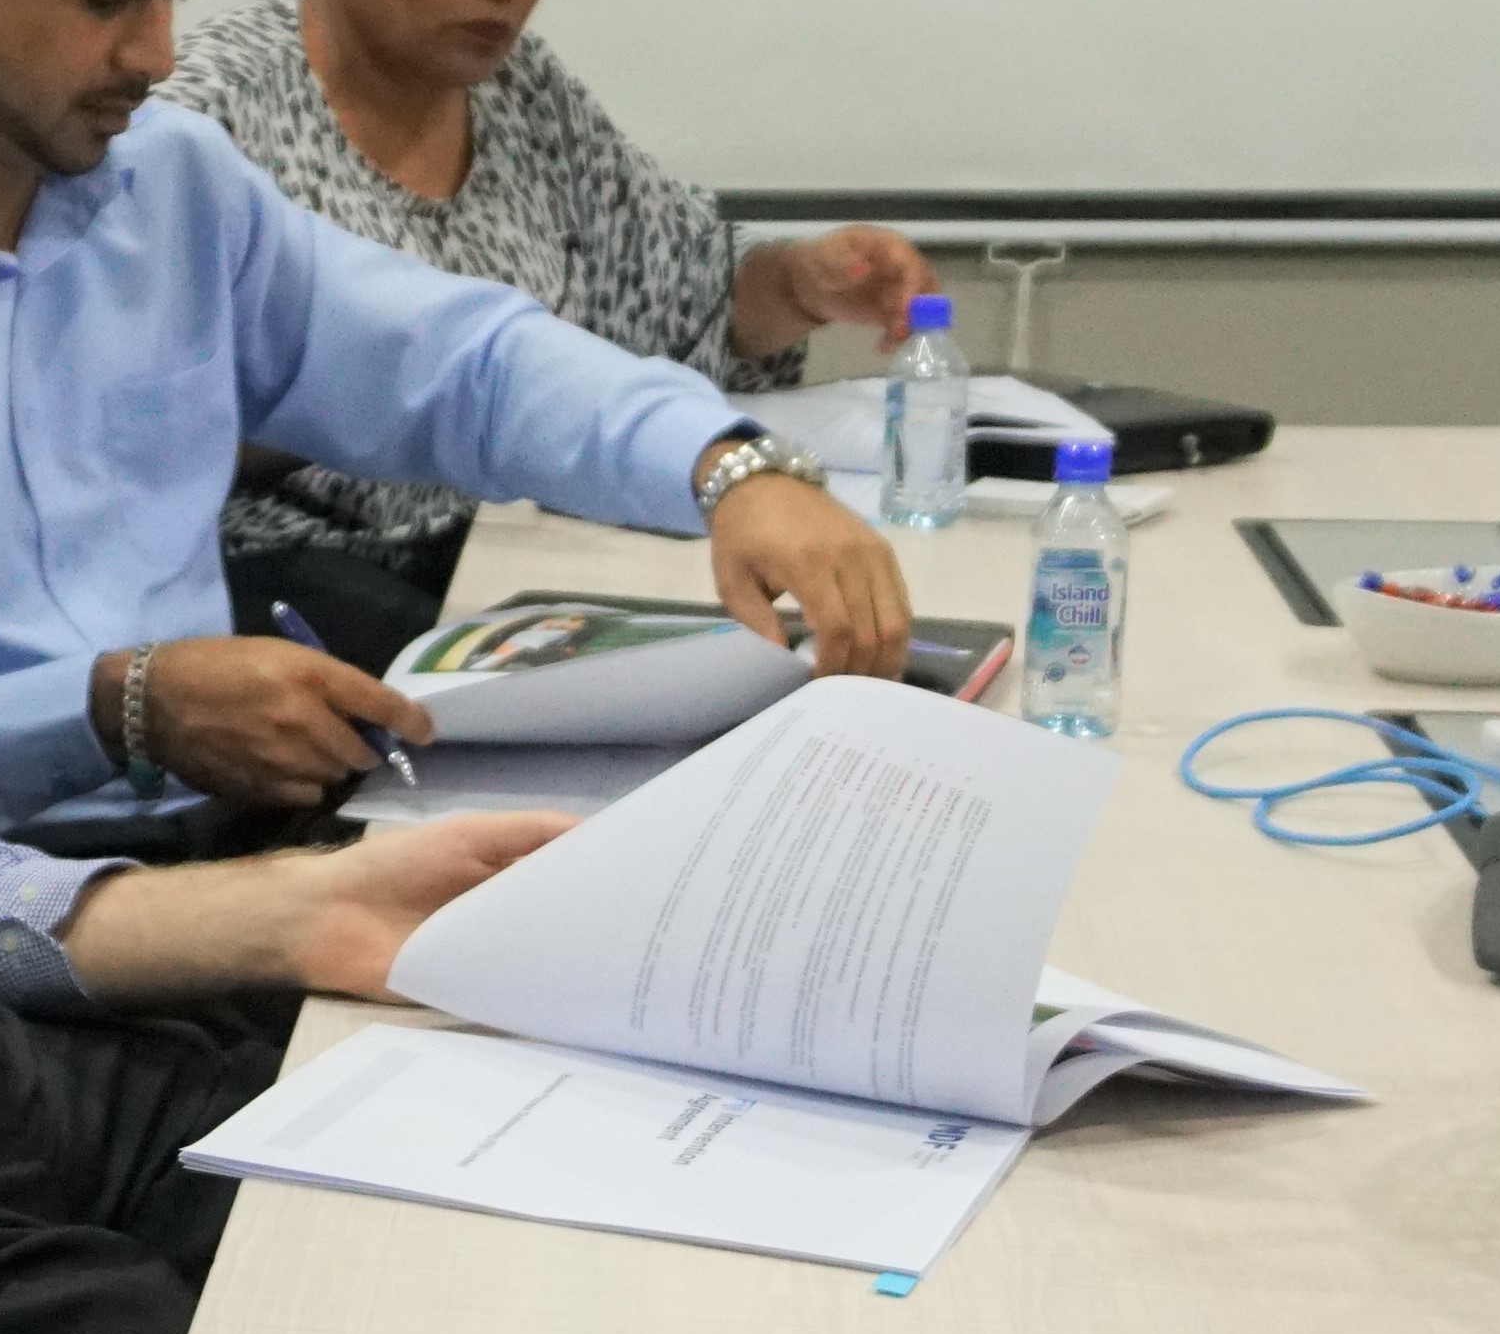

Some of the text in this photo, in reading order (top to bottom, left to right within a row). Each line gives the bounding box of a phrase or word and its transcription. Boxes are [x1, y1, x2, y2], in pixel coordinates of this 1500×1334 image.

[1050, 581, 1110, 603] Island
[1056, 603, 1103, 626] Chill
[657, 1091, 720, 1141] Agreement
[671, 1112, 742, 1165] Intervention
[923, 1122, 974, 1151] MDF
